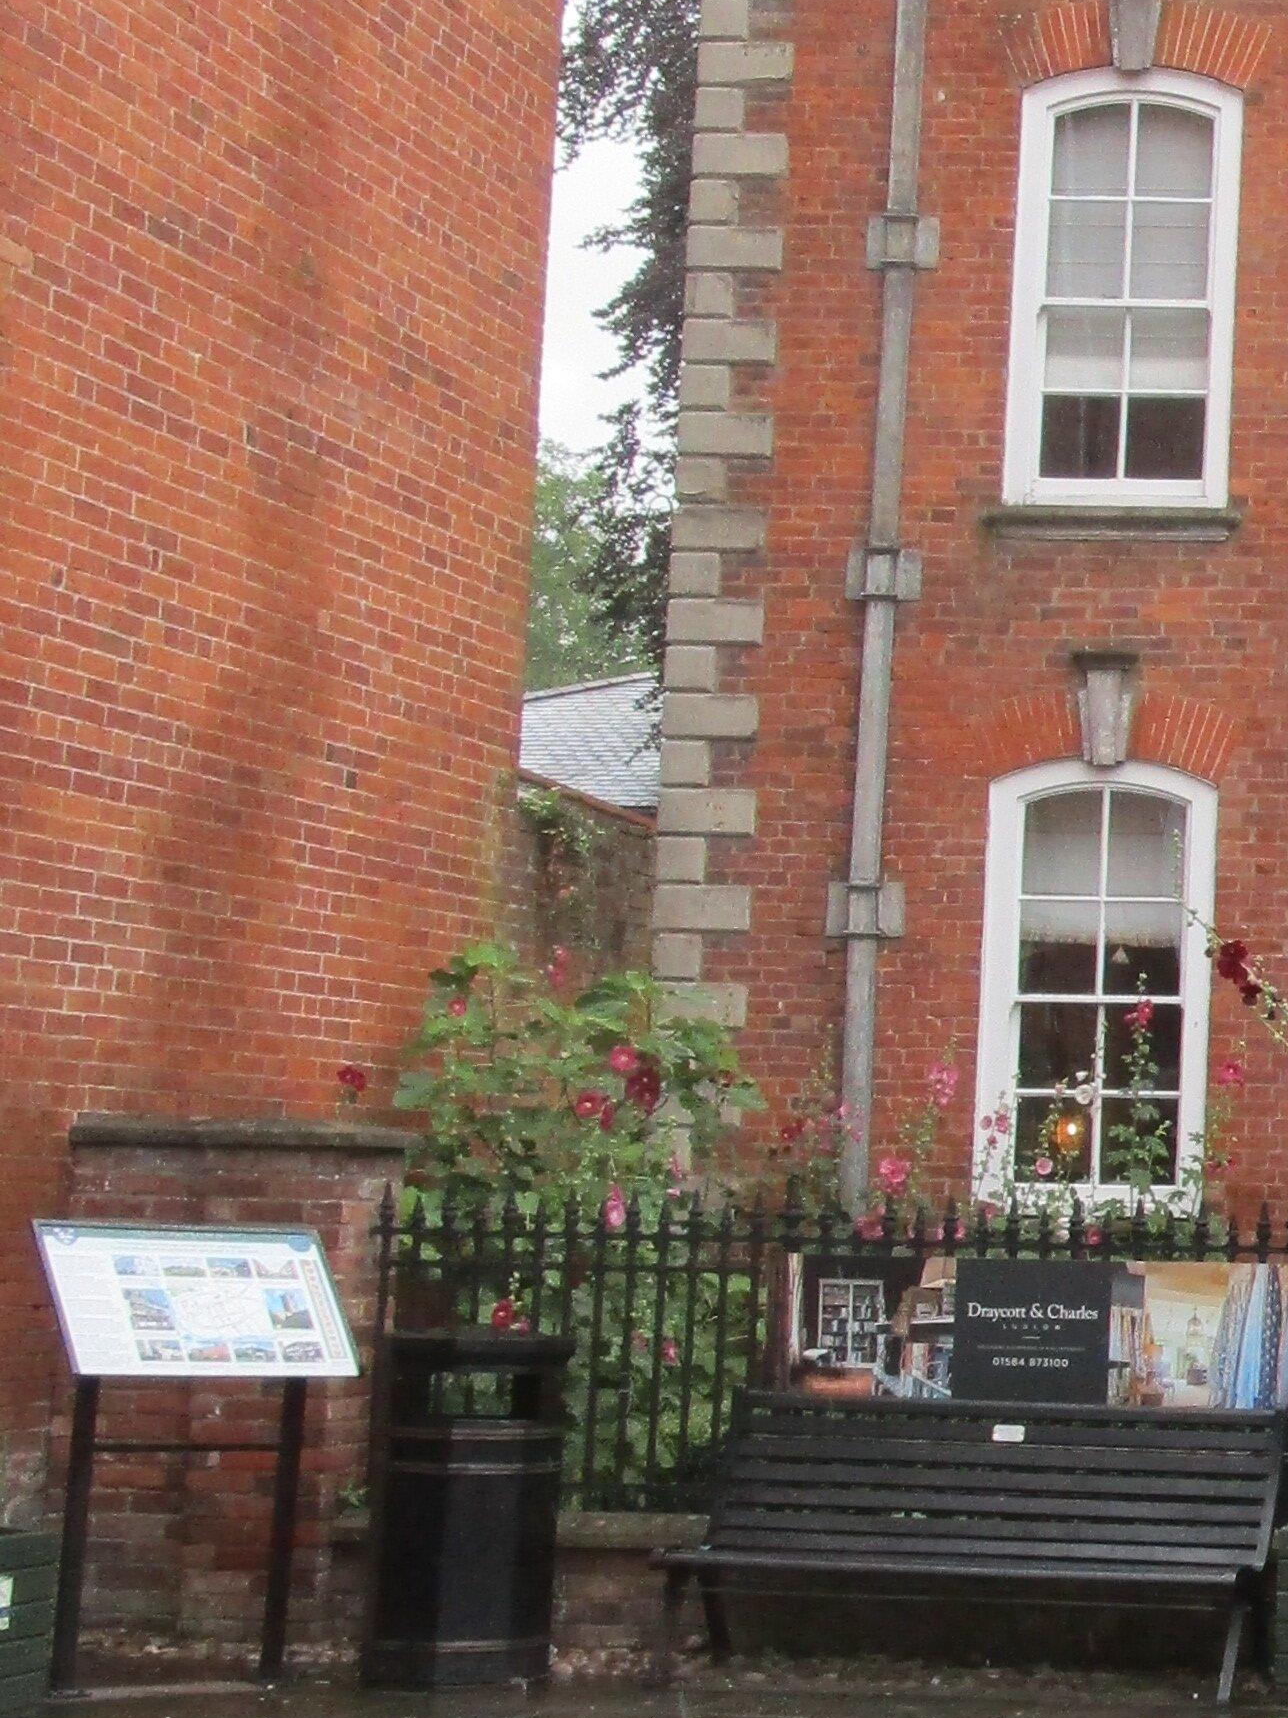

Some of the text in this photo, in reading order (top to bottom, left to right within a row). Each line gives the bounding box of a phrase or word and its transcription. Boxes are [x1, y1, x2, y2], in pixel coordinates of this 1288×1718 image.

[967, 1302, 1099, 1321] Draycott & Charles
